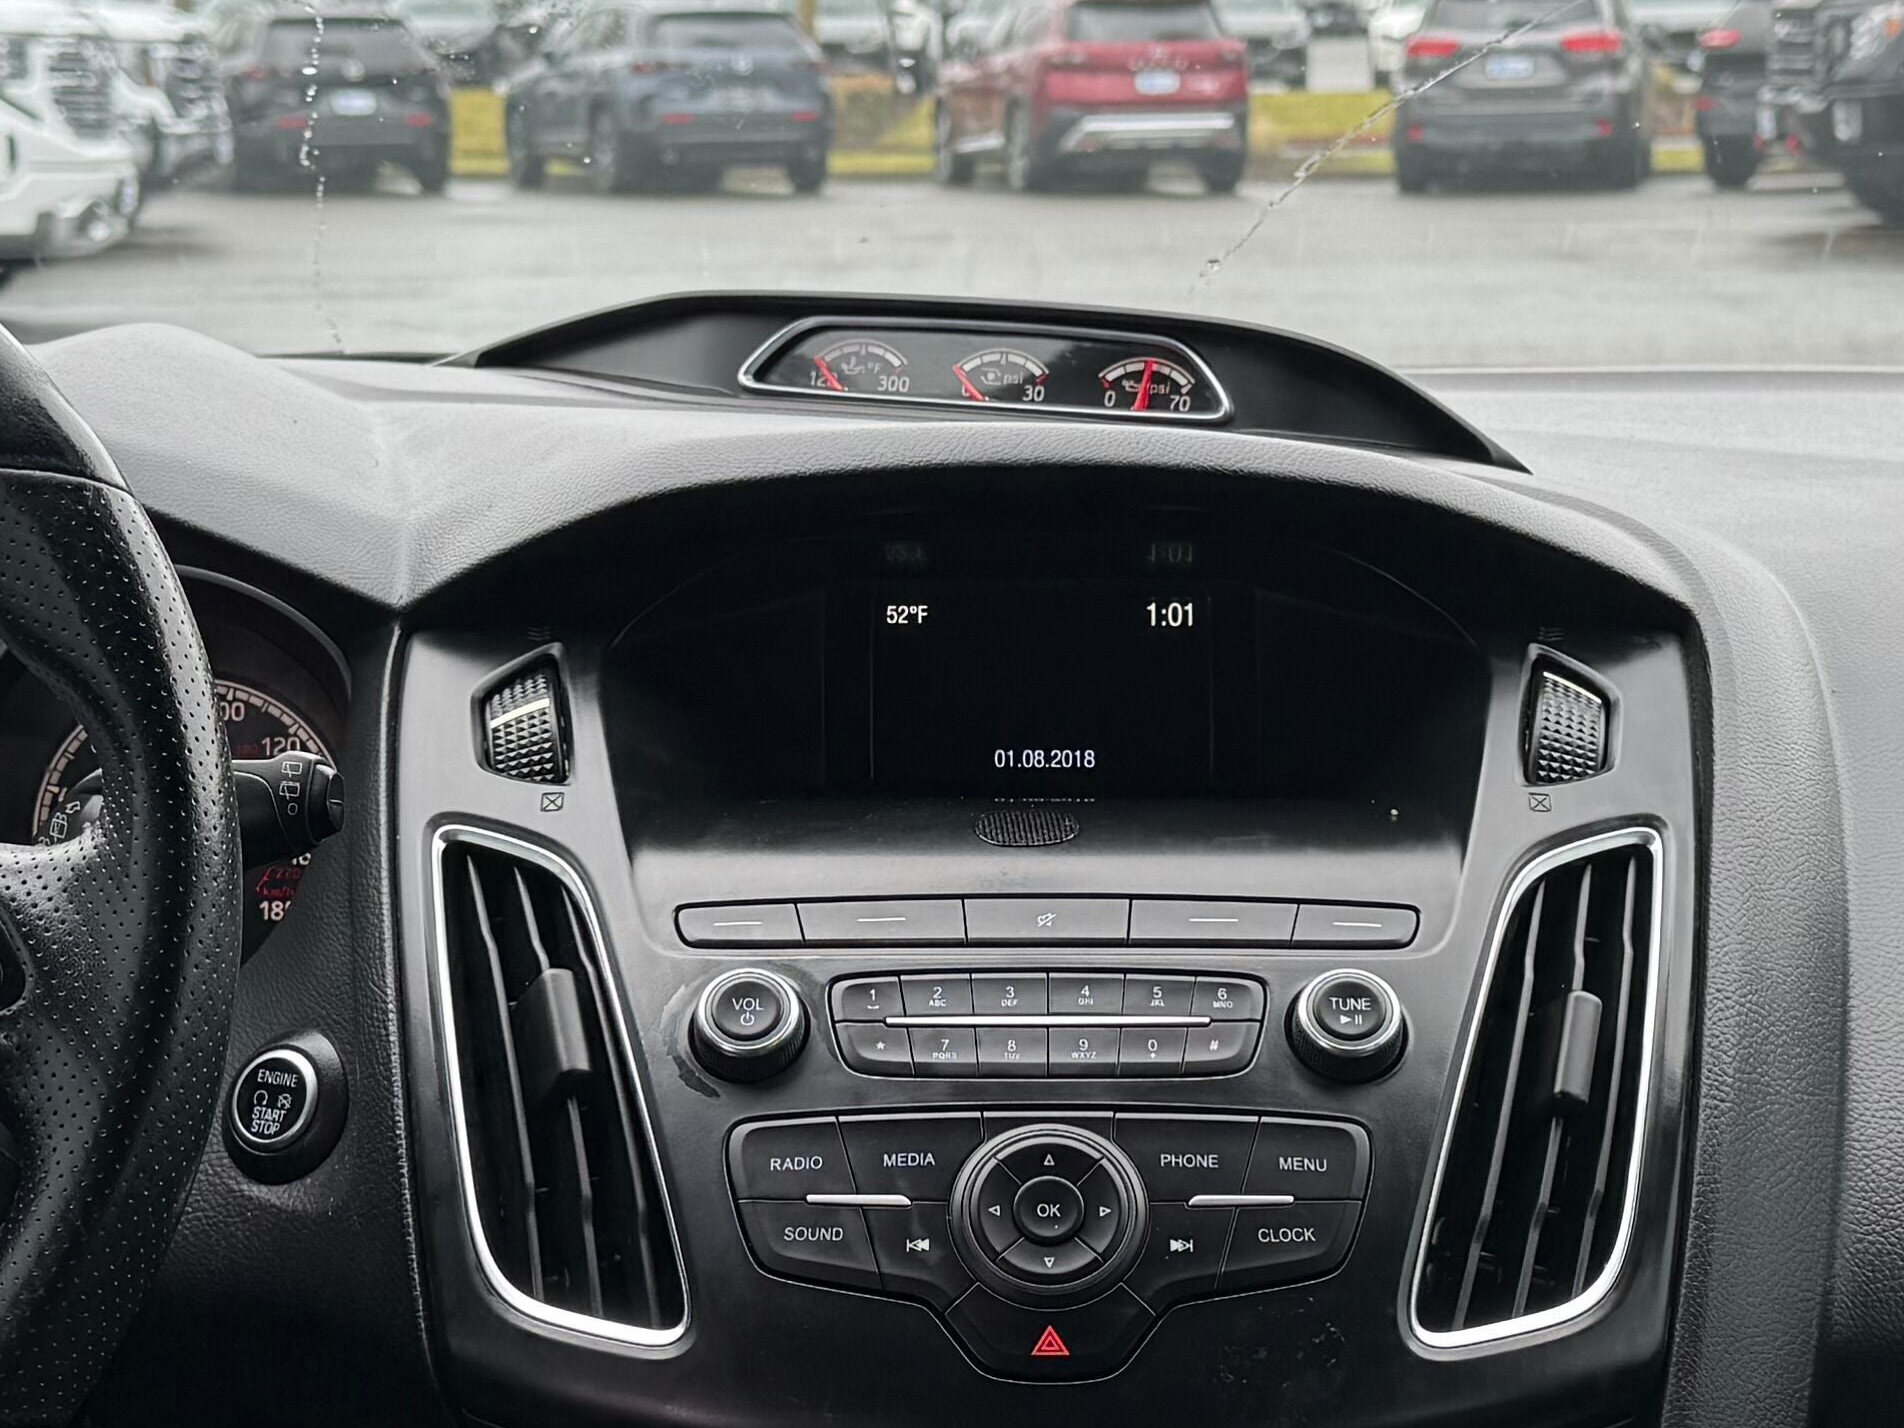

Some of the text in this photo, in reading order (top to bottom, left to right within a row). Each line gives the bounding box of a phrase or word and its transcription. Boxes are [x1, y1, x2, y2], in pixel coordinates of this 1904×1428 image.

[877, 375, 910, 393] 300
[1002, 371, 1024, 386] psi
[1022, 384, 1045, 403] 30
[1103, 389, 1116, 408] 0
[1169, 394, 1192, 413] 70
[886, 604, 929, 625] 52°F
[1146, 602, 1195, 627] 1:01
[220, 701, 245, 722] 00
[261, 736, 301, 757] 120
[994, 748, 1096, 770] 01.08.2018
[933, 986, 943, 998] 2
[1005, 986, 1015, 998] 3
[1080, 985, 1090, 997] 4
[1152, 986, 1162, 999] 5
[1217, 987, 1228, 1000] 6
[731, 997, 764, 1012] VOL
[928, 999, 946, 1007] ABC
[1001, 999, 1018, 1007] DEF
[1329, 996, 1371, 1012] TUNE
[941, 1039, 950, 1052] 7
[1007, 1039, 1016, 1052] 8
[1078, 1038, 1089, 1051] 9
[1147, 1039, 1158, 1052] 0
[1071, 1051, 1096, 1060] WXYZ
[257, 1068, 300, 1088] ENGINE
[251, 1105, 287, 1123] START
[251, 1119, 281, 1135] STOP
[769, 1155, 823, 1172] RADIO
[882, 1152, 936, 1168] MEDIA
[1159, 1153, 1219, 1169] PHONE
[1278, 1156, 1328, 1172] MENU
[1036, 1203, 1062, 1218] OK
[783, 1226, 844, 1242] SOUND
[1257, 1226, 1316, 1243] CLOCK
